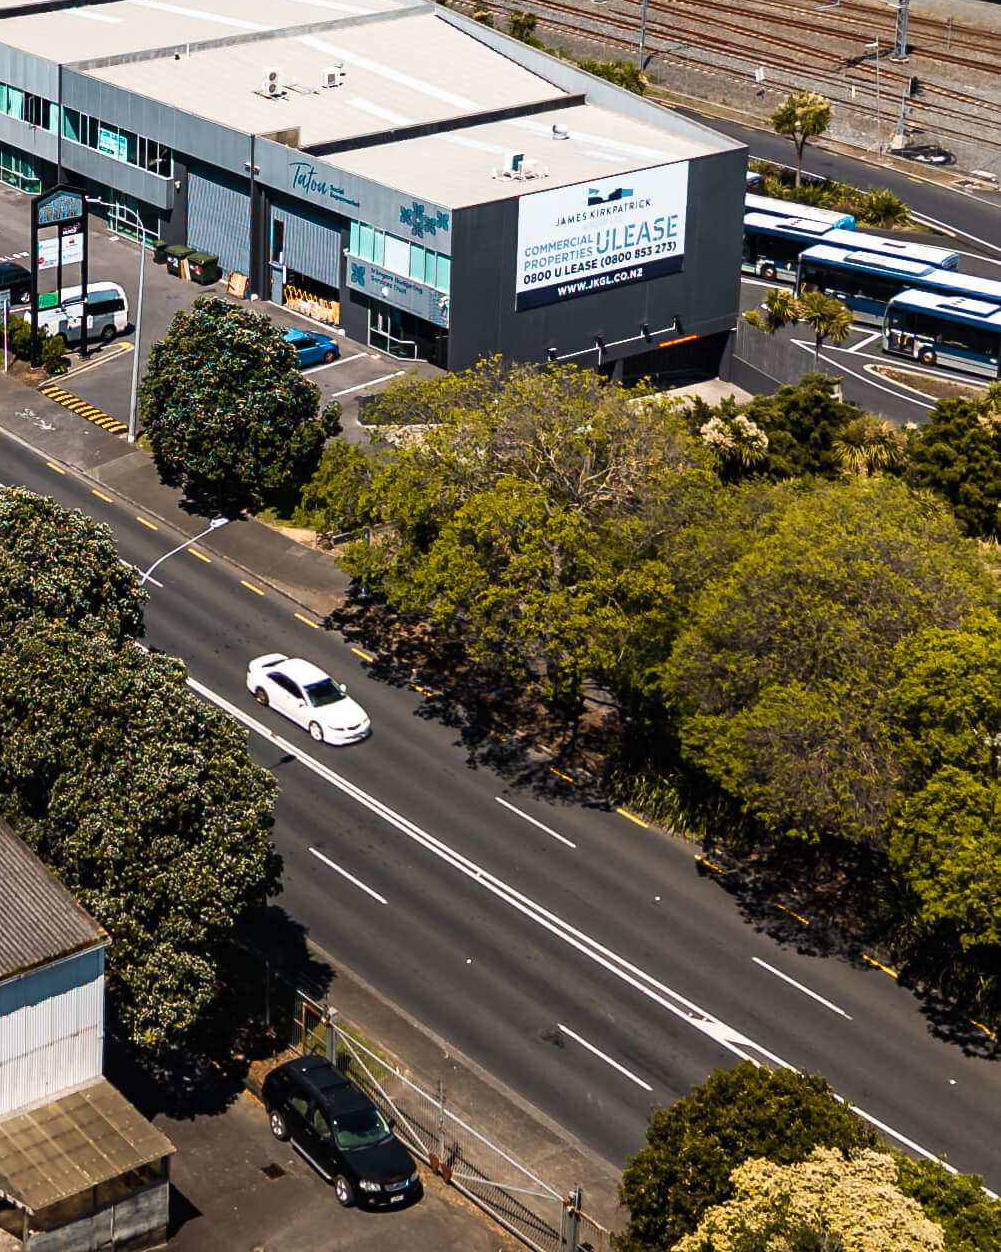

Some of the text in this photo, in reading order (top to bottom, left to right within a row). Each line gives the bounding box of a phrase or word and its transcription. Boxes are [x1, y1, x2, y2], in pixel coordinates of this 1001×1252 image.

[555, 199, 652, 227] JAMES KIRKPATRICK
[524, 235, 594, 258] COMMERCIAL
[596, 215, 678, 254] ULEASE
[523, 241, 677, 285] 0800 U LEASE (0800 853 273)
[524, 247, 593, 272] PROPERTIES
[557, 267, 644, 297] WWW.JKGL.CO.NZ
